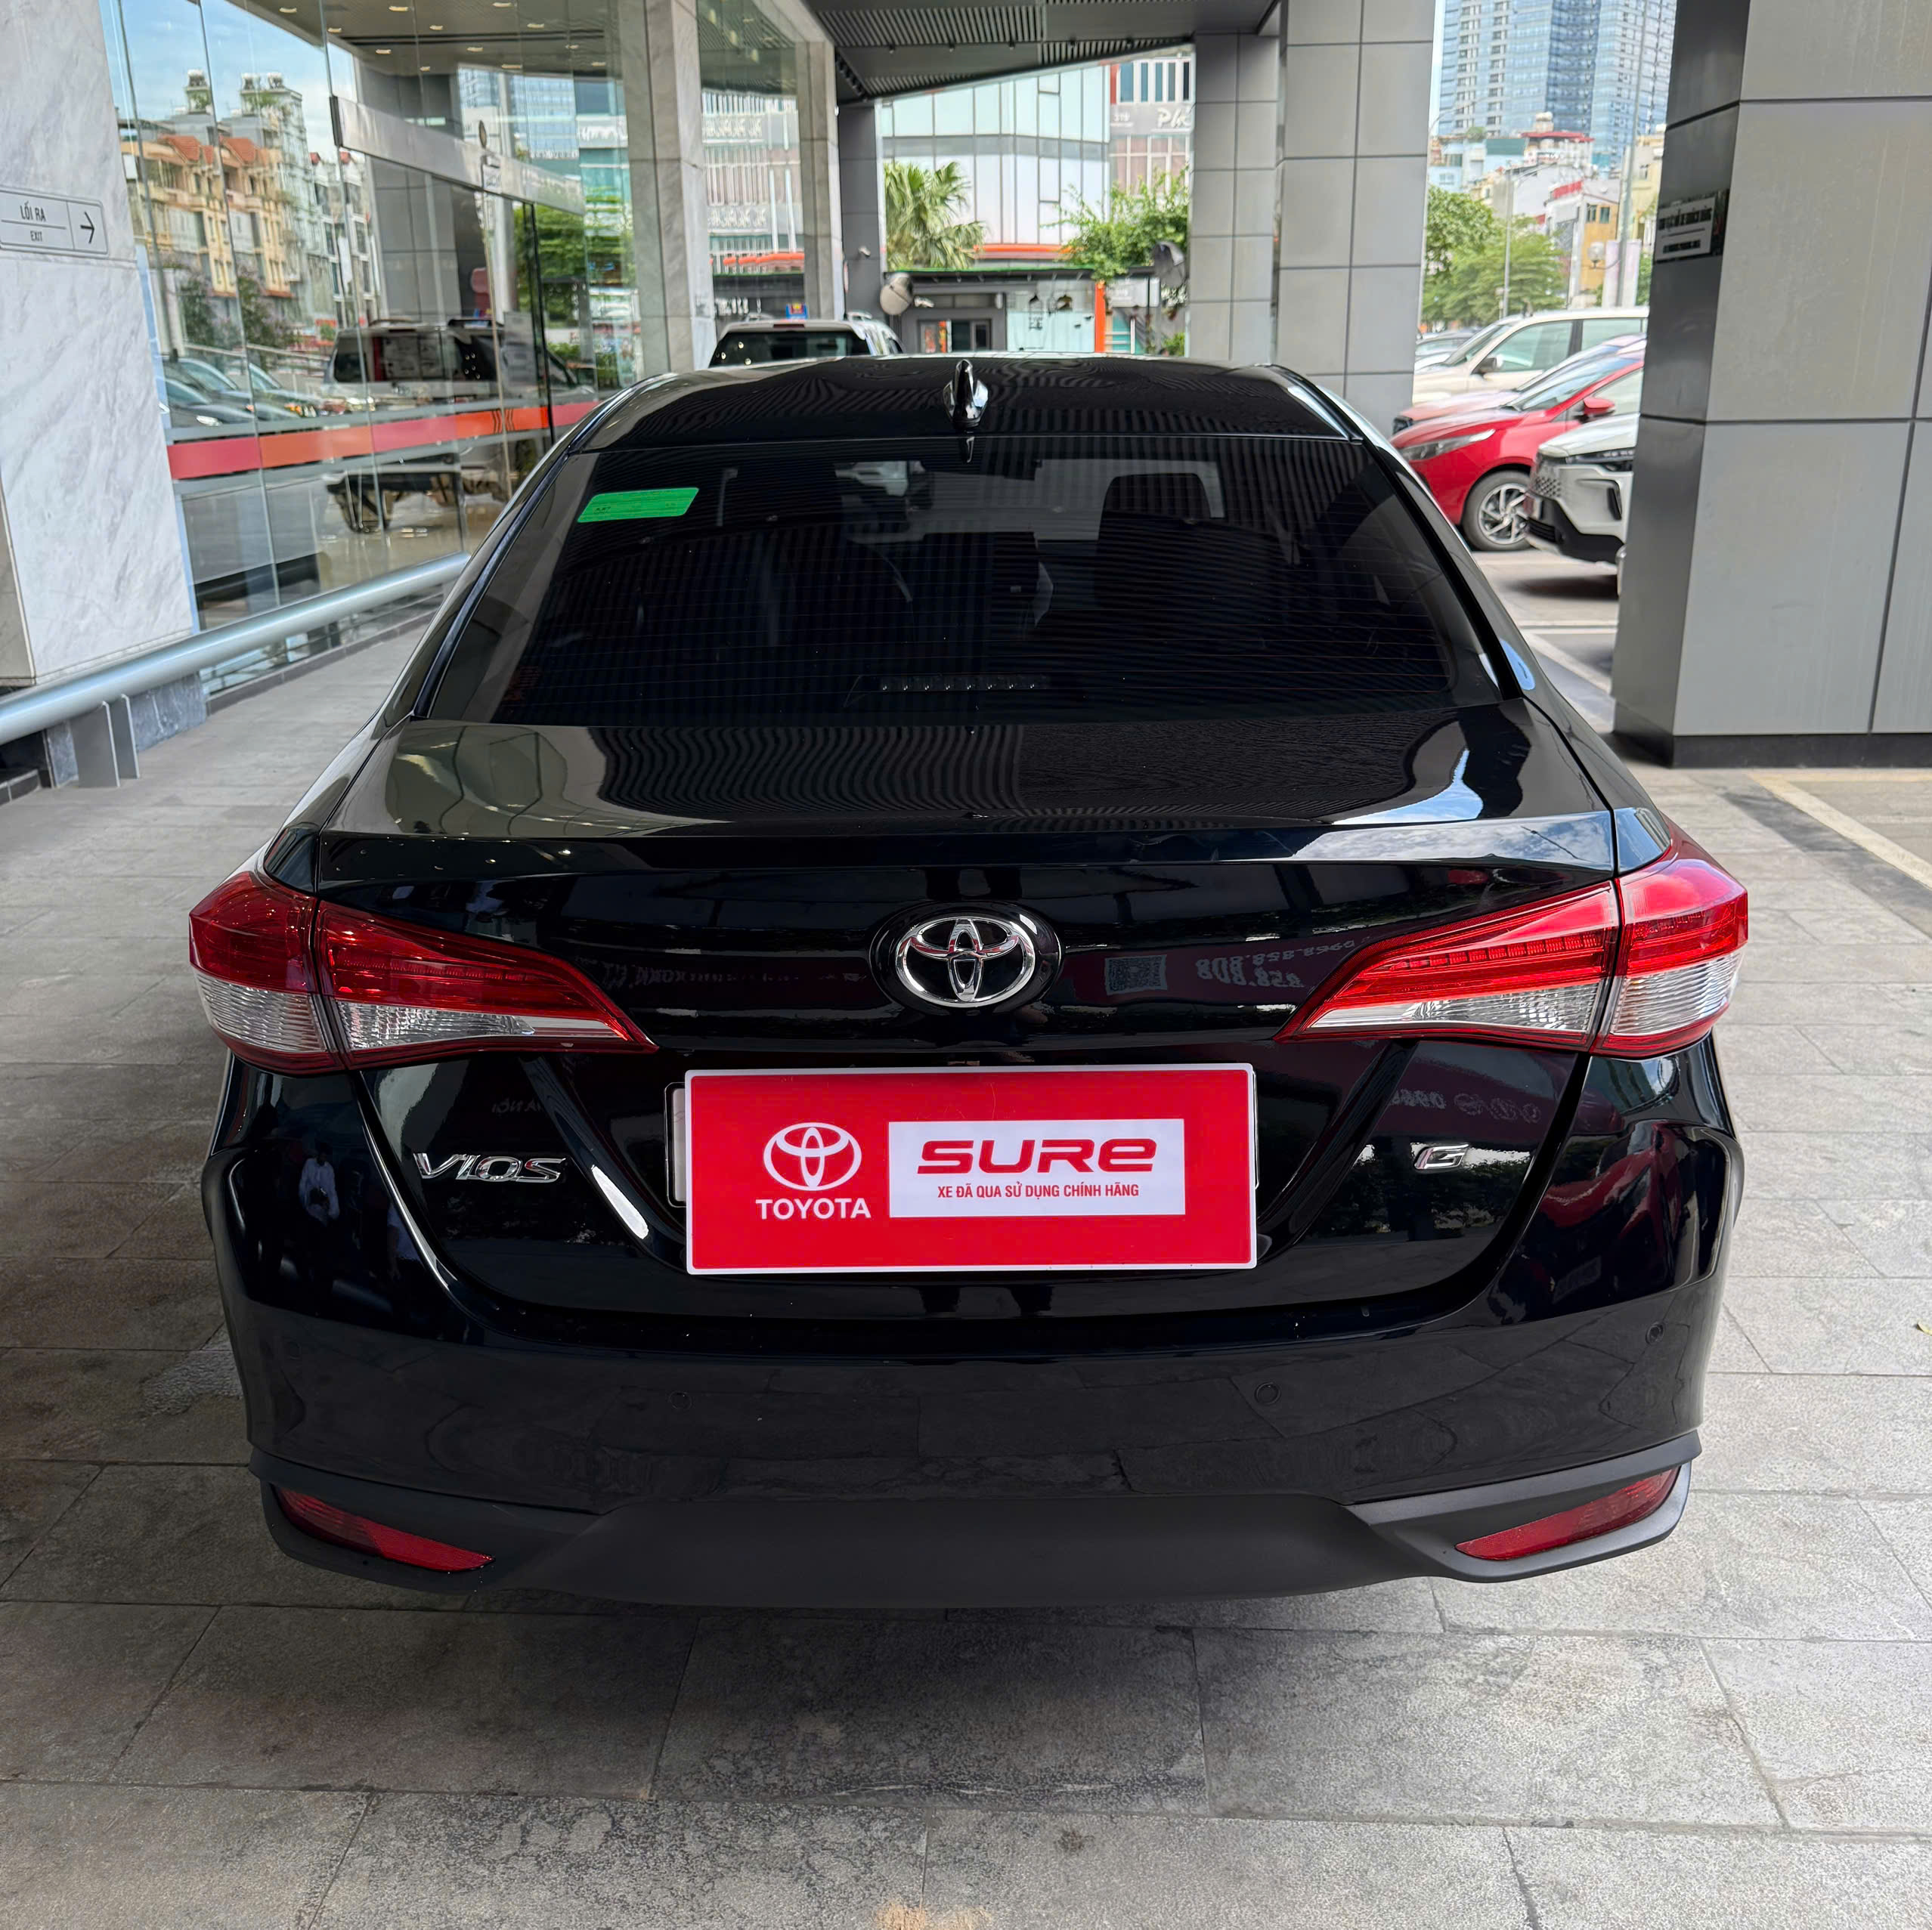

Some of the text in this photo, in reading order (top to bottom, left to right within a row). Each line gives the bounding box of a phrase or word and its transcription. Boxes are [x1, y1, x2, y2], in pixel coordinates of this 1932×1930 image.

[20, 201, 46, 222] LỐI RA
[30, 230, 43, 242] EXIT
[1414, 1144, 1469, 1169] G
[413, 1153, 566, 1183] VIOS
[937, 1180, 1139, 1200] XE ĐÃ QUA SỬ DỤNG CHÍNH HÃNG
[755, 1198, 872, 1220] TOYOTA
